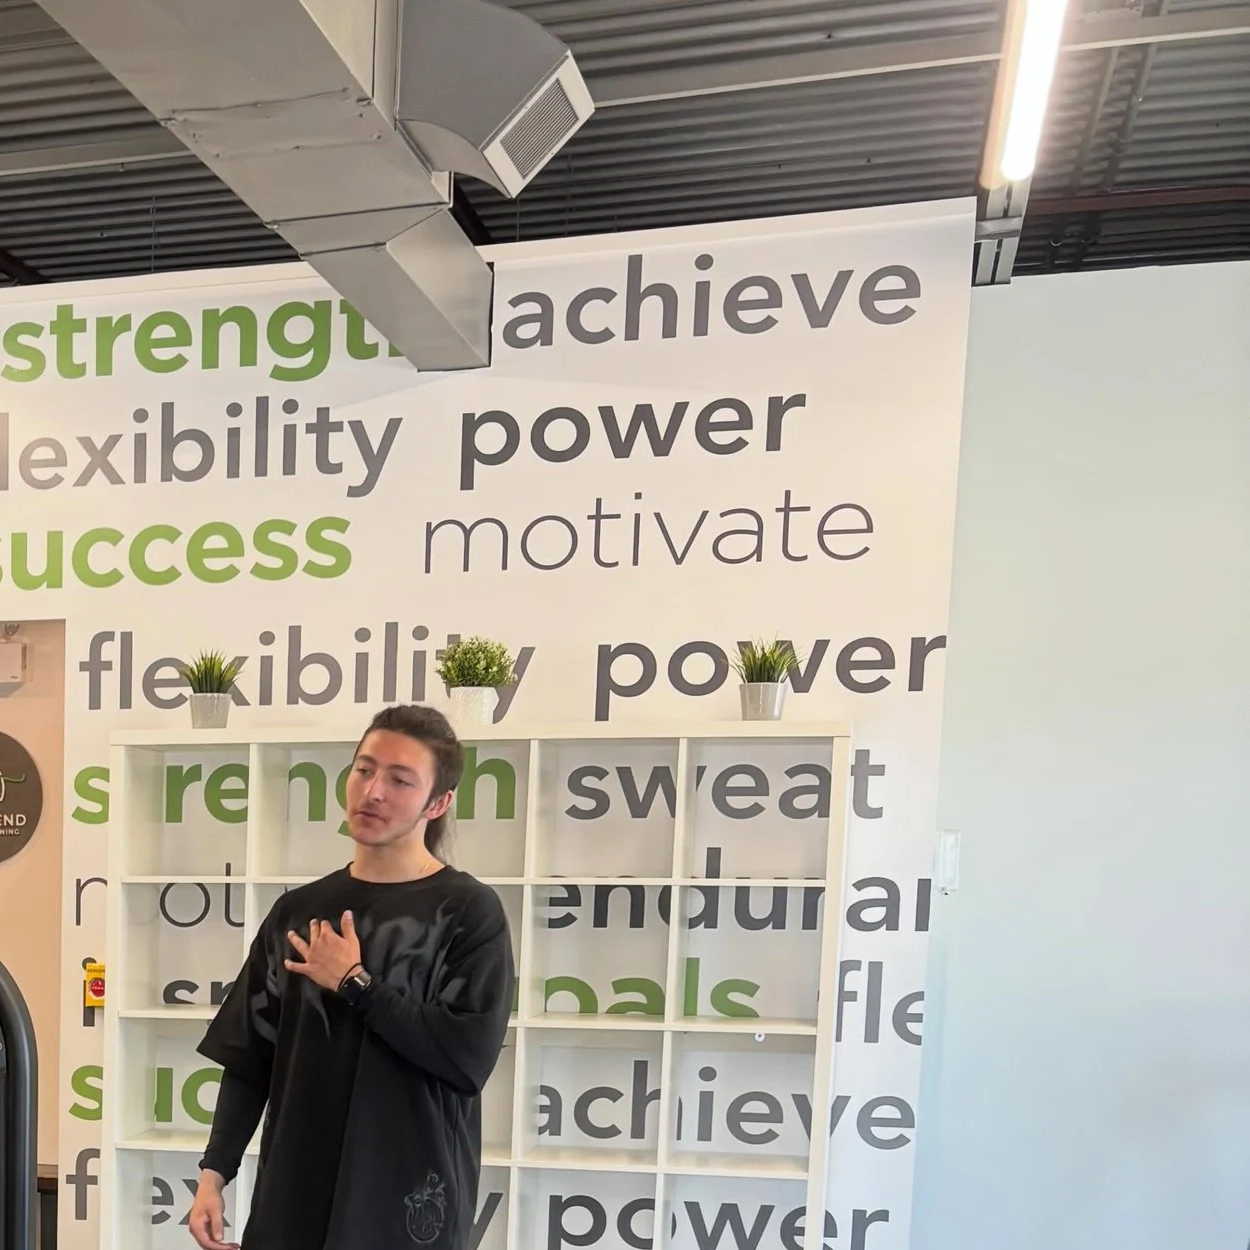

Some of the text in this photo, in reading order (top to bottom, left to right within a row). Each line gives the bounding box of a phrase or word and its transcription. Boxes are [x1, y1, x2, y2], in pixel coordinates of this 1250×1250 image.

[0, 299, 404, 382] strengt
[501, 253, 921, 348] achieve
[459, 392, 806, 491] power
[423, 488, 874, 573] motivate
[78, 621, 537, 725] fleibiliy
[594, 634, 947, 722] power
[564, 749, 886, 820] sweat
[514, 956, 761, 1017] oals
[538, 1059, 916, 1151] achieve
